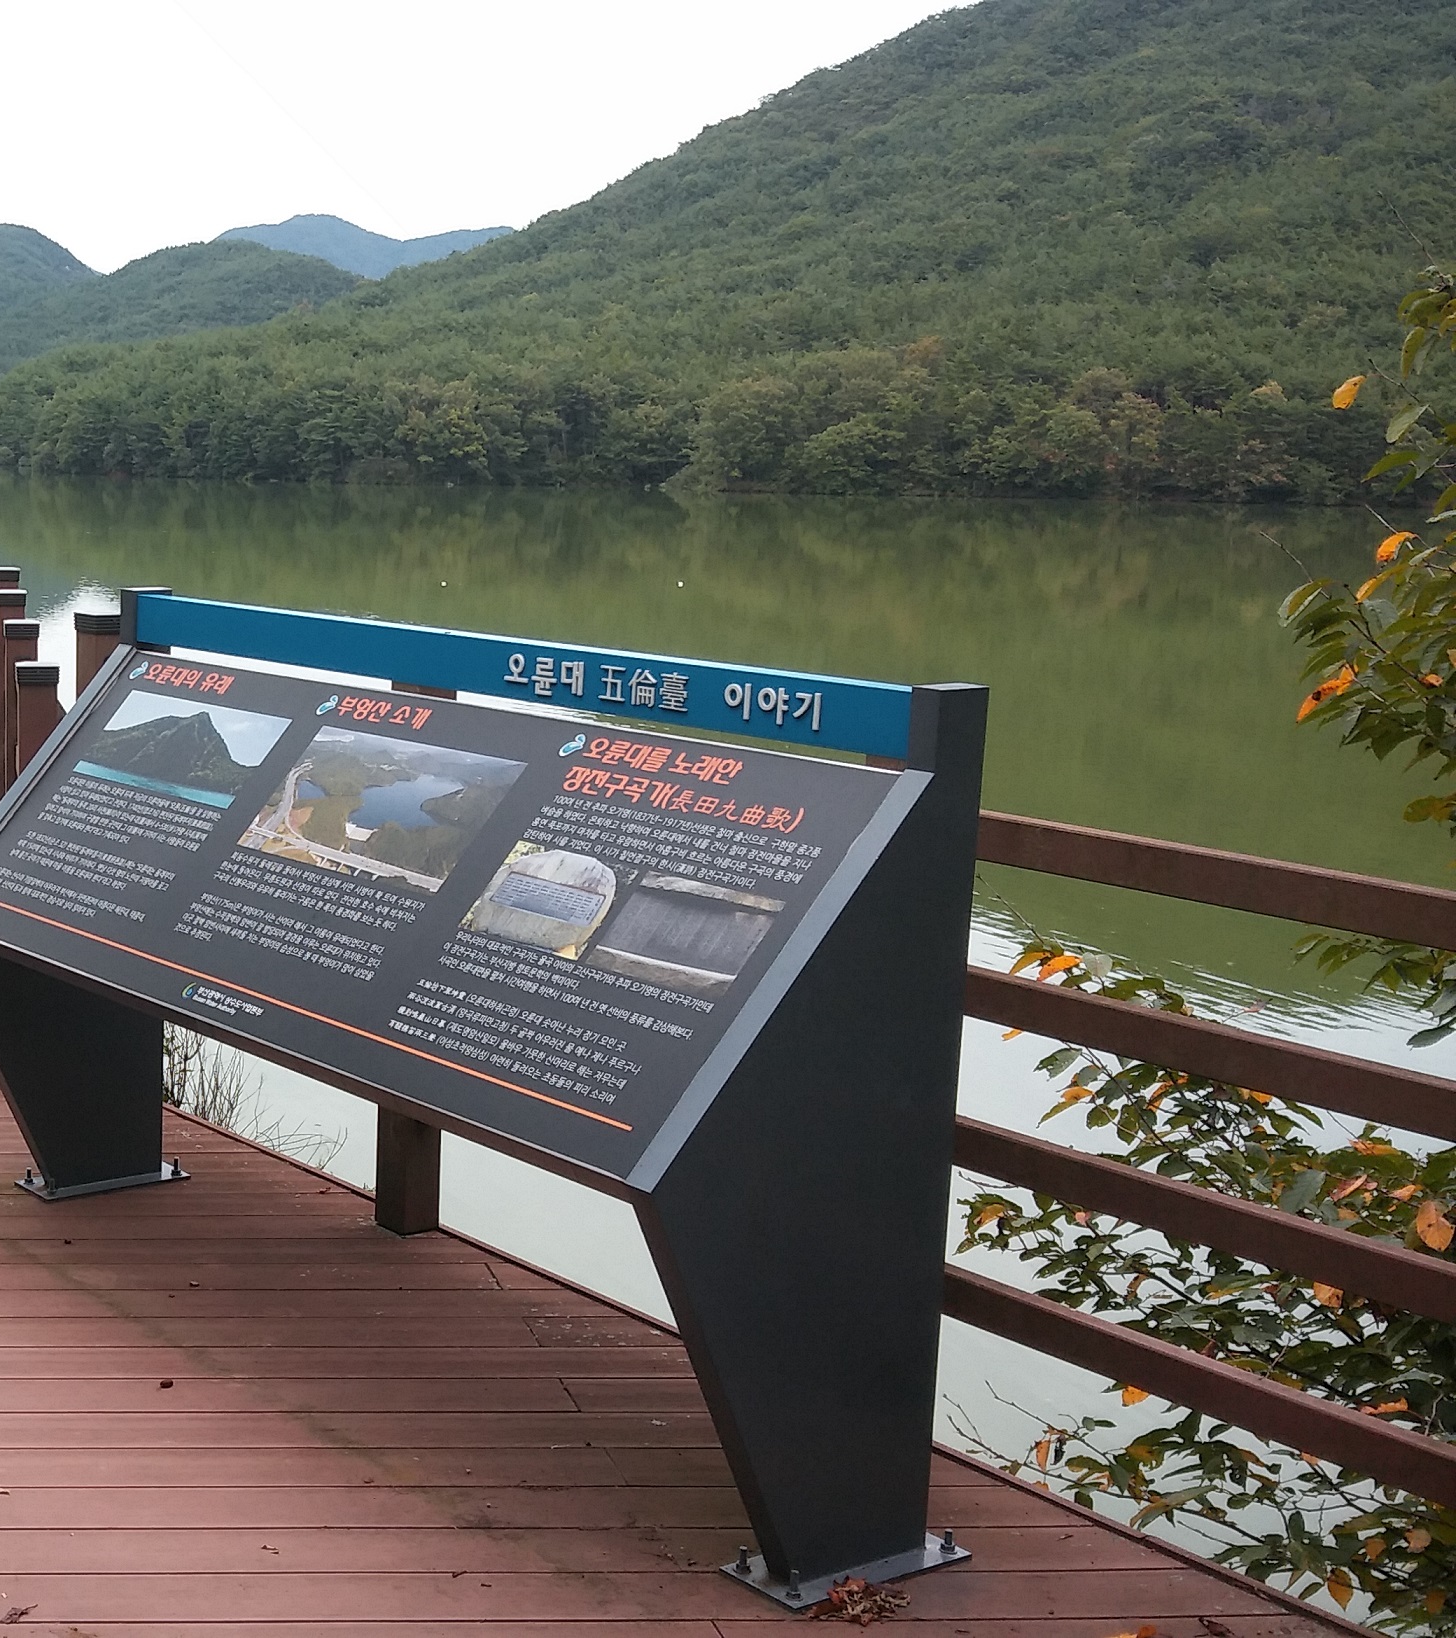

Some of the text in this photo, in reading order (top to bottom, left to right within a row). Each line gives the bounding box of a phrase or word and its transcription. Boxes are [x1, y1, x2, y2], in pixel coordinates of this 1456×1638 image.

[146, 663, 234, 694] 오륜대의 유래
[503, 652, 824, 732] 오륜대 五倫臺 이야기
[339, 696, 432, 730] 부엉산 소개
[584, 737, 743, 785] 오륜대를 노래한
